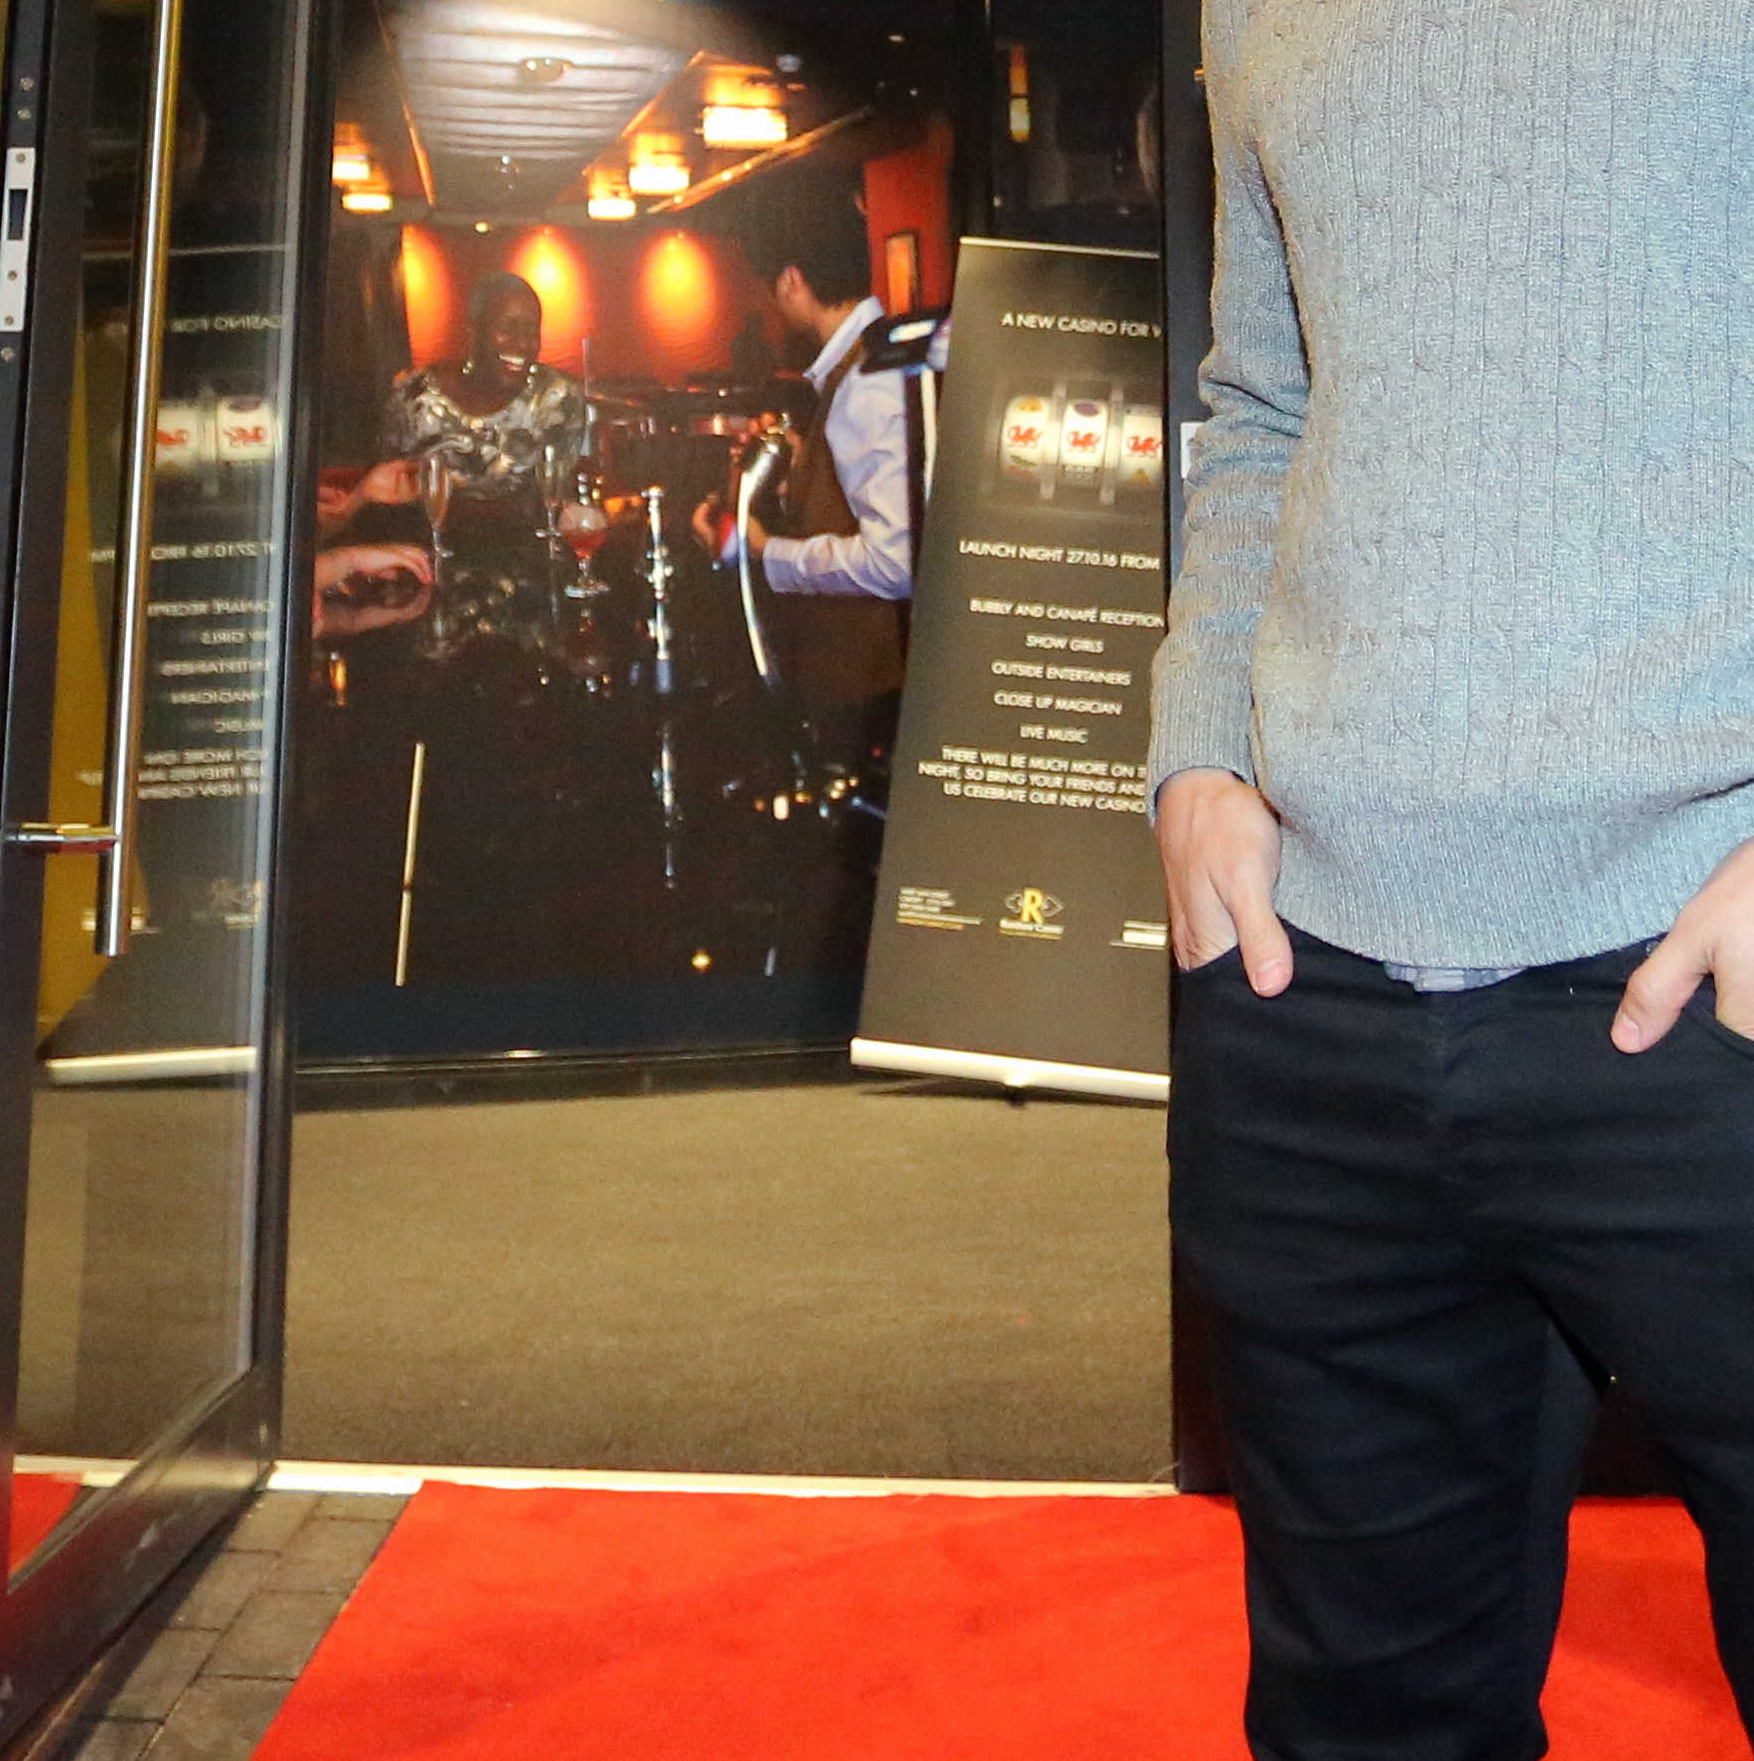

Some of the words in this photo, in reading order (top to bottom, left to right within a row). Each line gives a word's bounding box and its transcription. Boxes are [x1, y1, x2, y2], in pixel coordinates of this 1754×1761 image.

[1001, 312, 1014, 327] A
[1017, 313, 1056, 330] NEW
[1057, 317, 1117, 335] CASINO
[1119, 321, 1150, 337] FOR
[959, 539, 1017, 559] LAUNCH
[1018, 546, 1065, 563] NIGHT
[1120, 554, 1161, 570] FROM
[1014, 603, 1045, 619] AND
[1099, 611, 1165, 628] RECEPTION
[1026, 633, 1068, 650] SHOW
[1069, 637, 1104, 654] GIRLS
[991, 660, 1044, 680] OUTSIDE
[1046, 665, 1133, 686] ENTERTAINERS
[994, 691, 1034, 709] CLOSE
[1035, 695, 1055, 710] UP
[1055, 698, 1123, 716] MAGICIAN
[1019, 724, 1045, 740] LIVE
[1046, 726, 1089, 744] MUSIC
[942, 745, 979, 764] THERE
[979, 750, 1009, 767] WILL
[1010, 753, 1028, 769] BE
[1029, 756, 1069, 772] MUCH
[1070, 759, 1110, 776] MORE
[1110, 763, 1136, 778] ON
[964, 766, 985, 781] SO
[985, 768, 1027, 786] BRING
[1027, 772, 1063, 789] YOUR
[1064, 776, 1117, 793] FRIENDS
[943, 780, 962, 796] US
[963, 783, 1028, 803] CELEBRATE
[1028, 790, 1059, 805] OUR
[1059, 793, 1095, 809] NEW
[1095, 796, 1147, 814] CASINO
[1021, 887, 1044, 923] R
